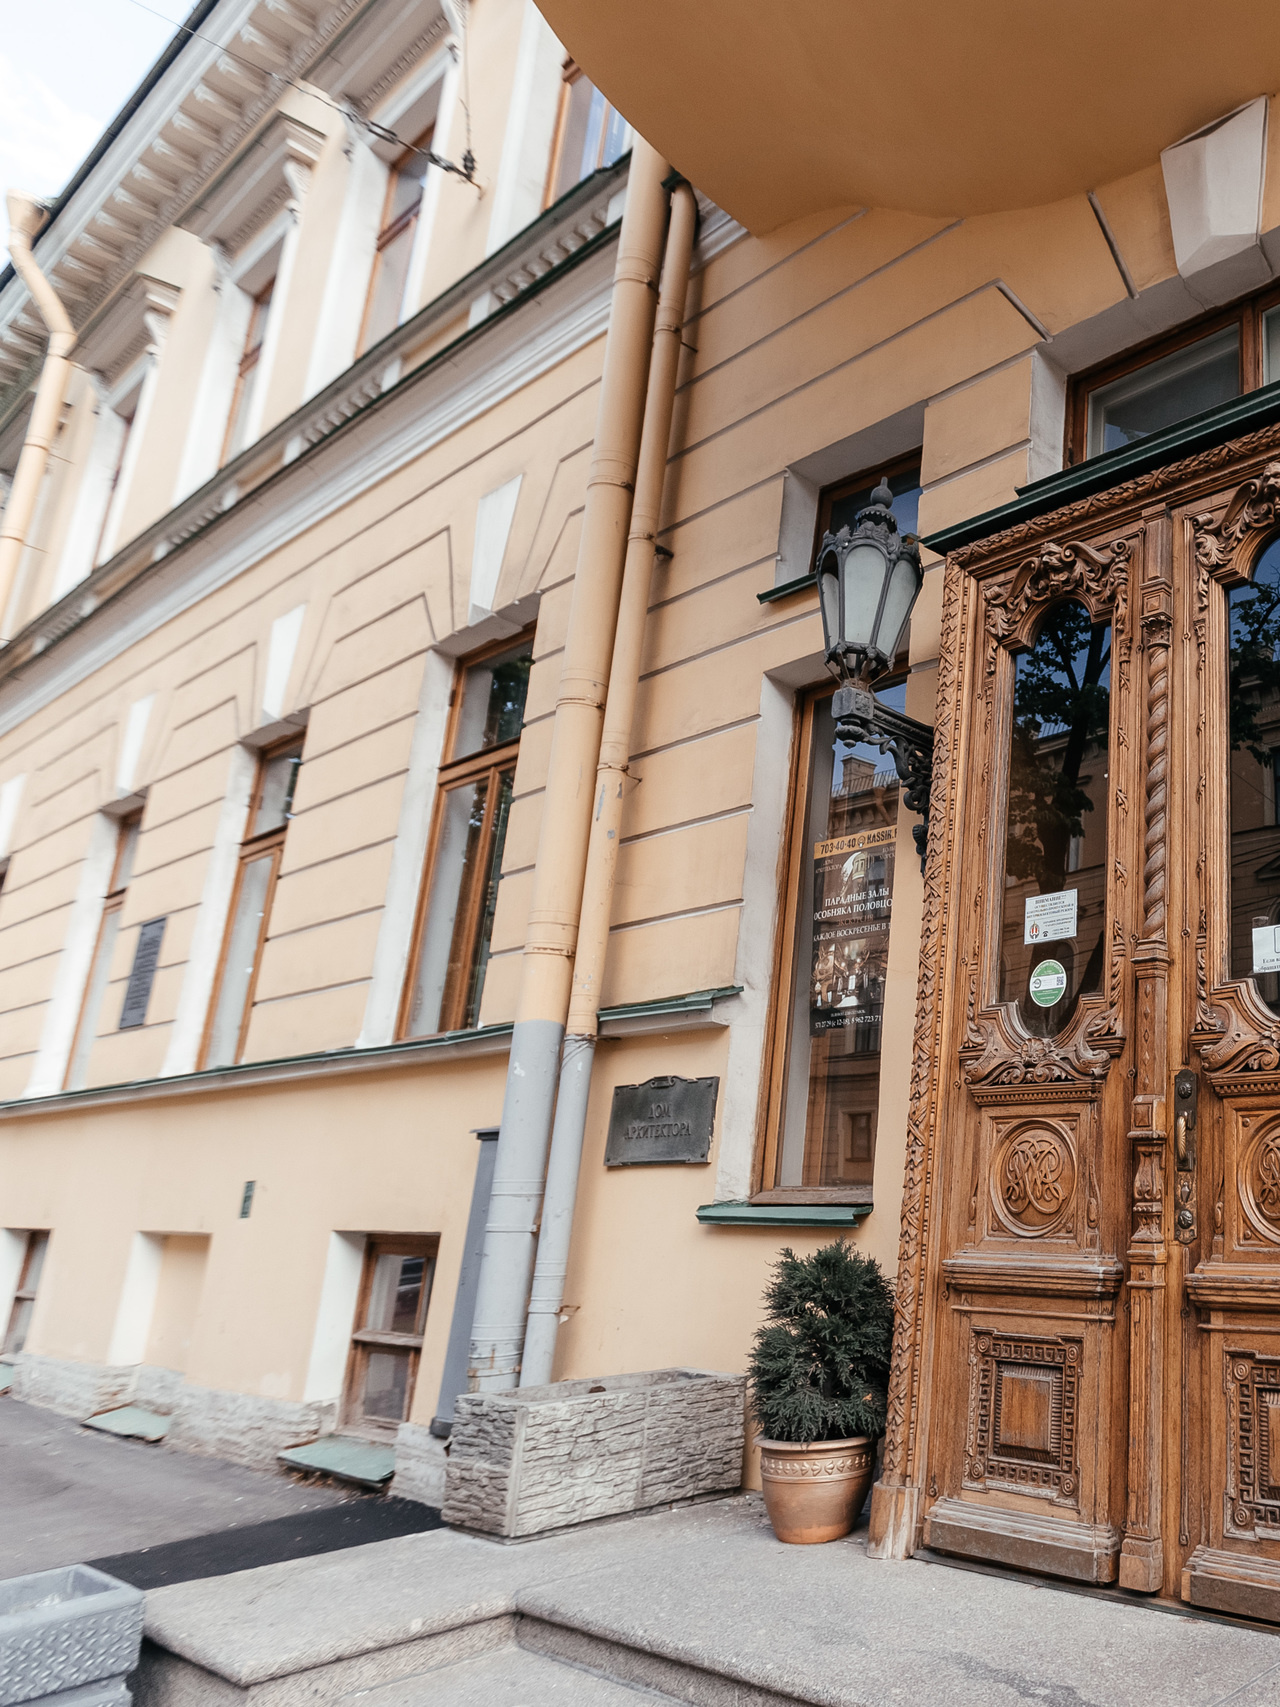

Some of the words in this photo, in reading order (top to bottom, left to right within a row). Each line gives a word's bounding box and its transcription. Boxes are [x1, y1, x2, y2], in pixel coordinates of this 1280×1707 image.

[824, 891, 867, 907] ПАРАДНЫЕ
[867, 887, 890, 899] ЗАЛЫ
[813, 906, 852, 920] ОСОБНЯКА
[836, 922, 881, 937] ВОСКРЕСЕНЬЕ
[648, 1102, 672, 1119] ДОМ
[623, 1121, 692, 1140] АРХИТЕКТОРА
